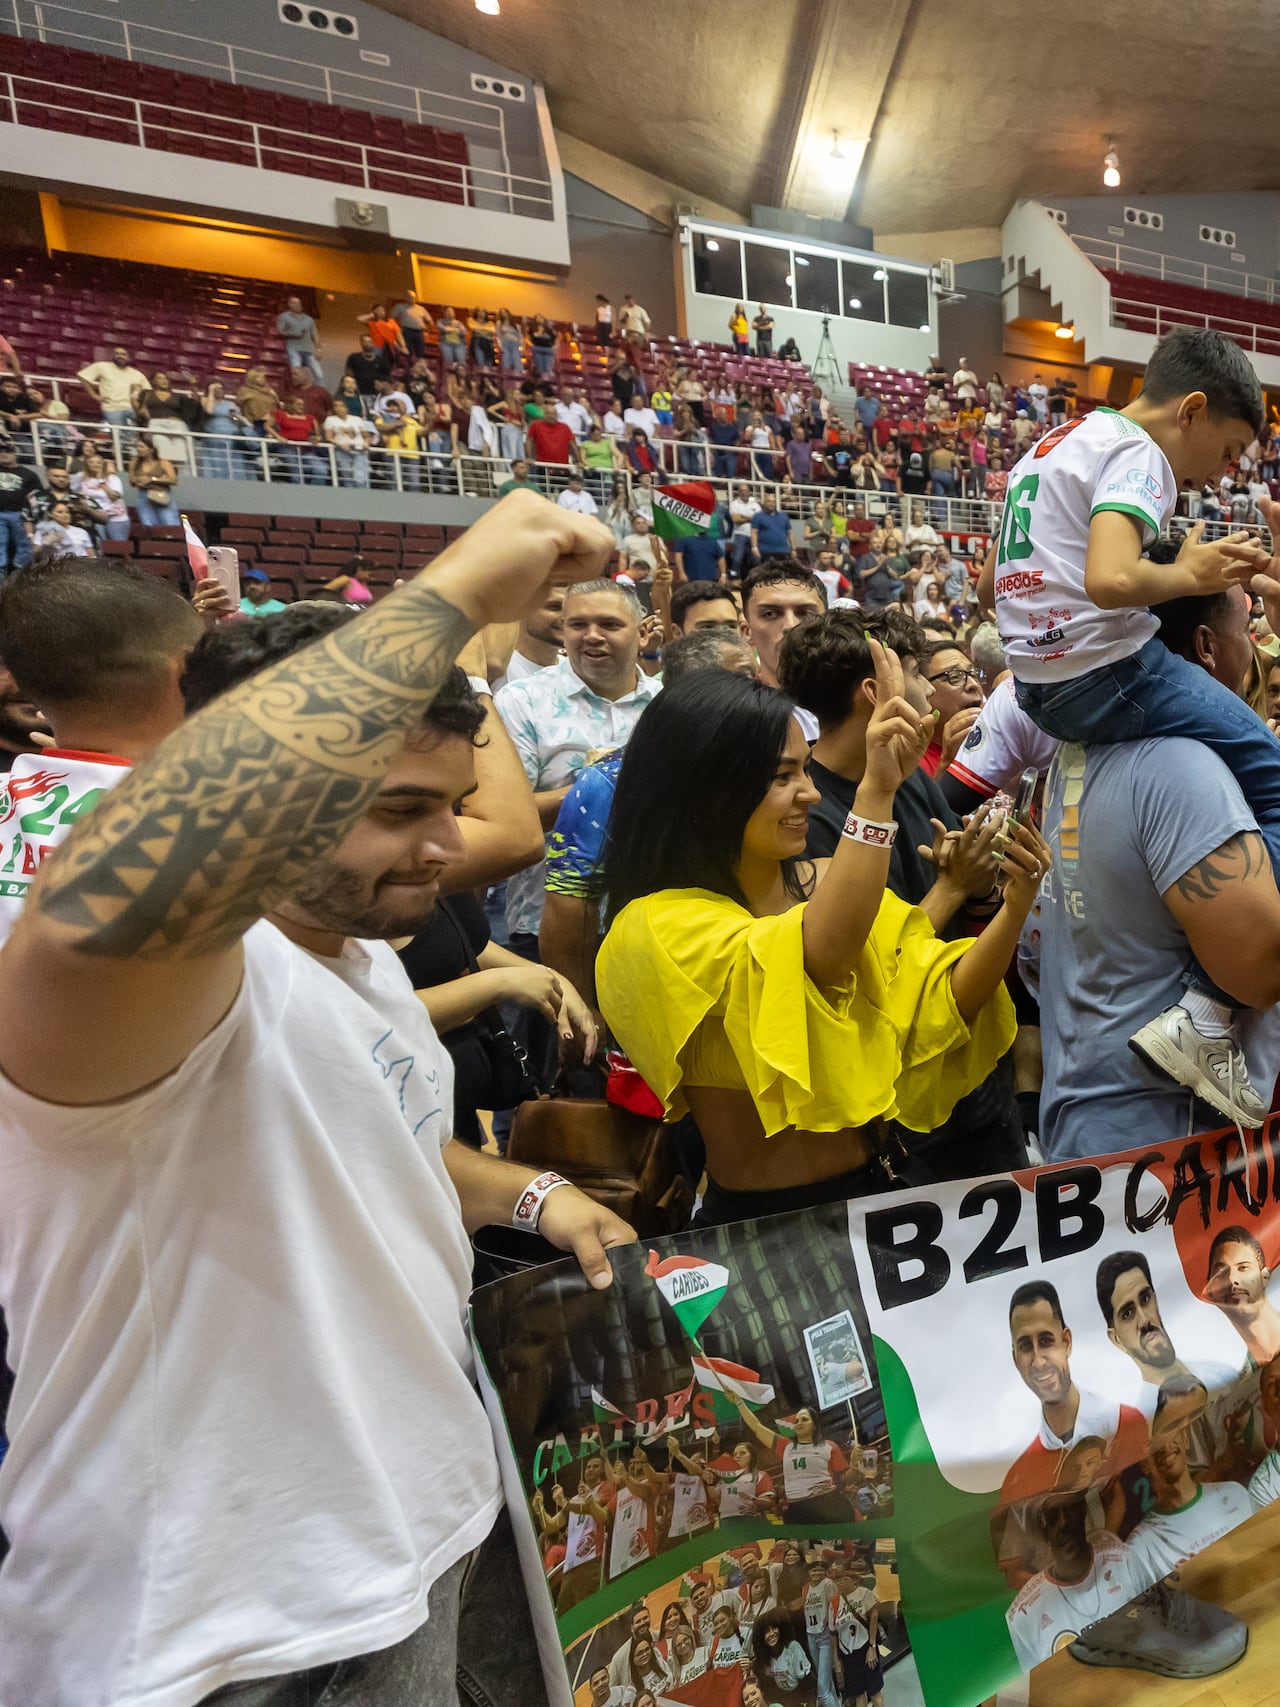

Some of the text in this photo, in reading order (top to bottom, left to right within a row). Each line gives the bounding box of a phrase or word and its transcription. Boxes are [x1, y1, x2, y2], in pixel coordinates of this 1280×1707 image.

[659, 496, 704, 523] CARIBES
[999, 473, 1039, 566] 16
[864, 1165, 1105, 1311] B2B
[792, 1457, 807, 1470] 14
